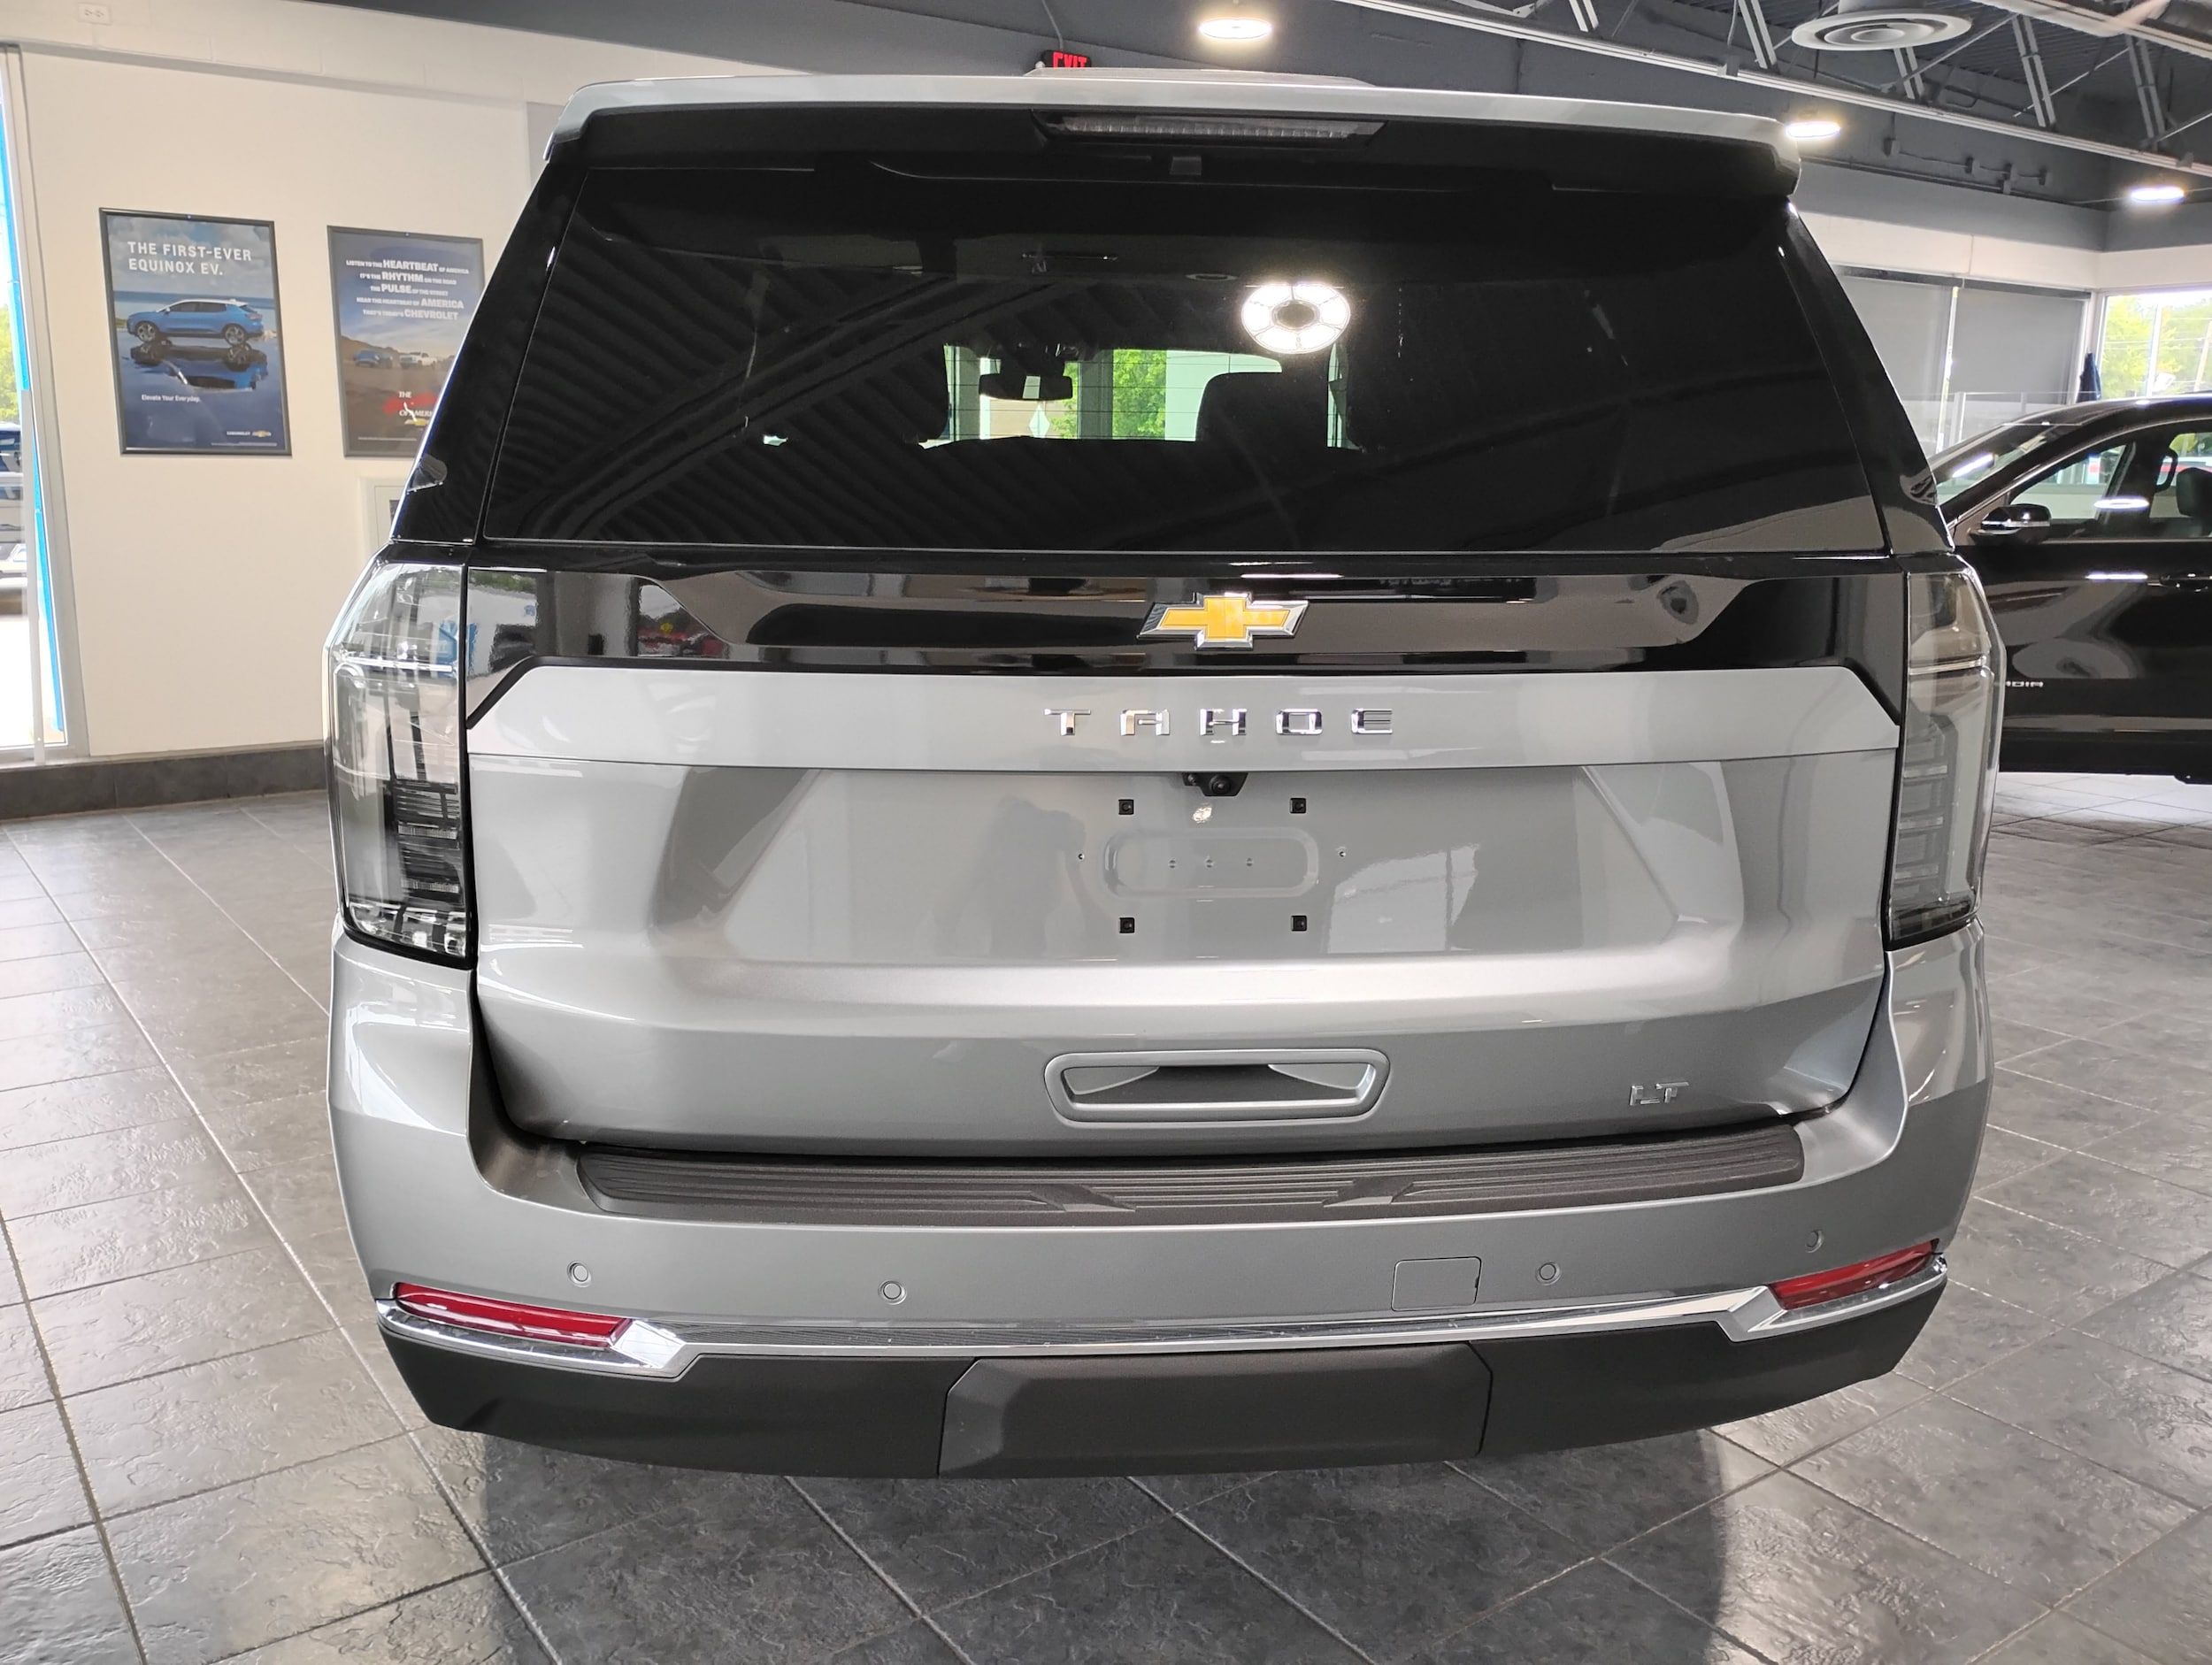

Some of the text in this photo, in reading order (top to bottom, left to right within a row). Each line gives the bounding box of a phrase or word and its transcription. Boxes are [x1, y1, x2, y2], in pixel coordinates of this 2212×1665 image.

[127, 241, 252, 262] THE FIRST-EVER
[128, 257, 224, 276] EQUINOX EV.
[382, 259, 439, 272] HEARTBEAT
[381, 271, 424, 283] RHYTHM
[380, 283, 411, 294] PULSE
[420, 297, 465, 310] AMERICA
[404, 308, 459, 320] CHEVROLET
[1043, 708, 1394, 736] TAHOE
[1629, 1082, 1689, 1106] LT
